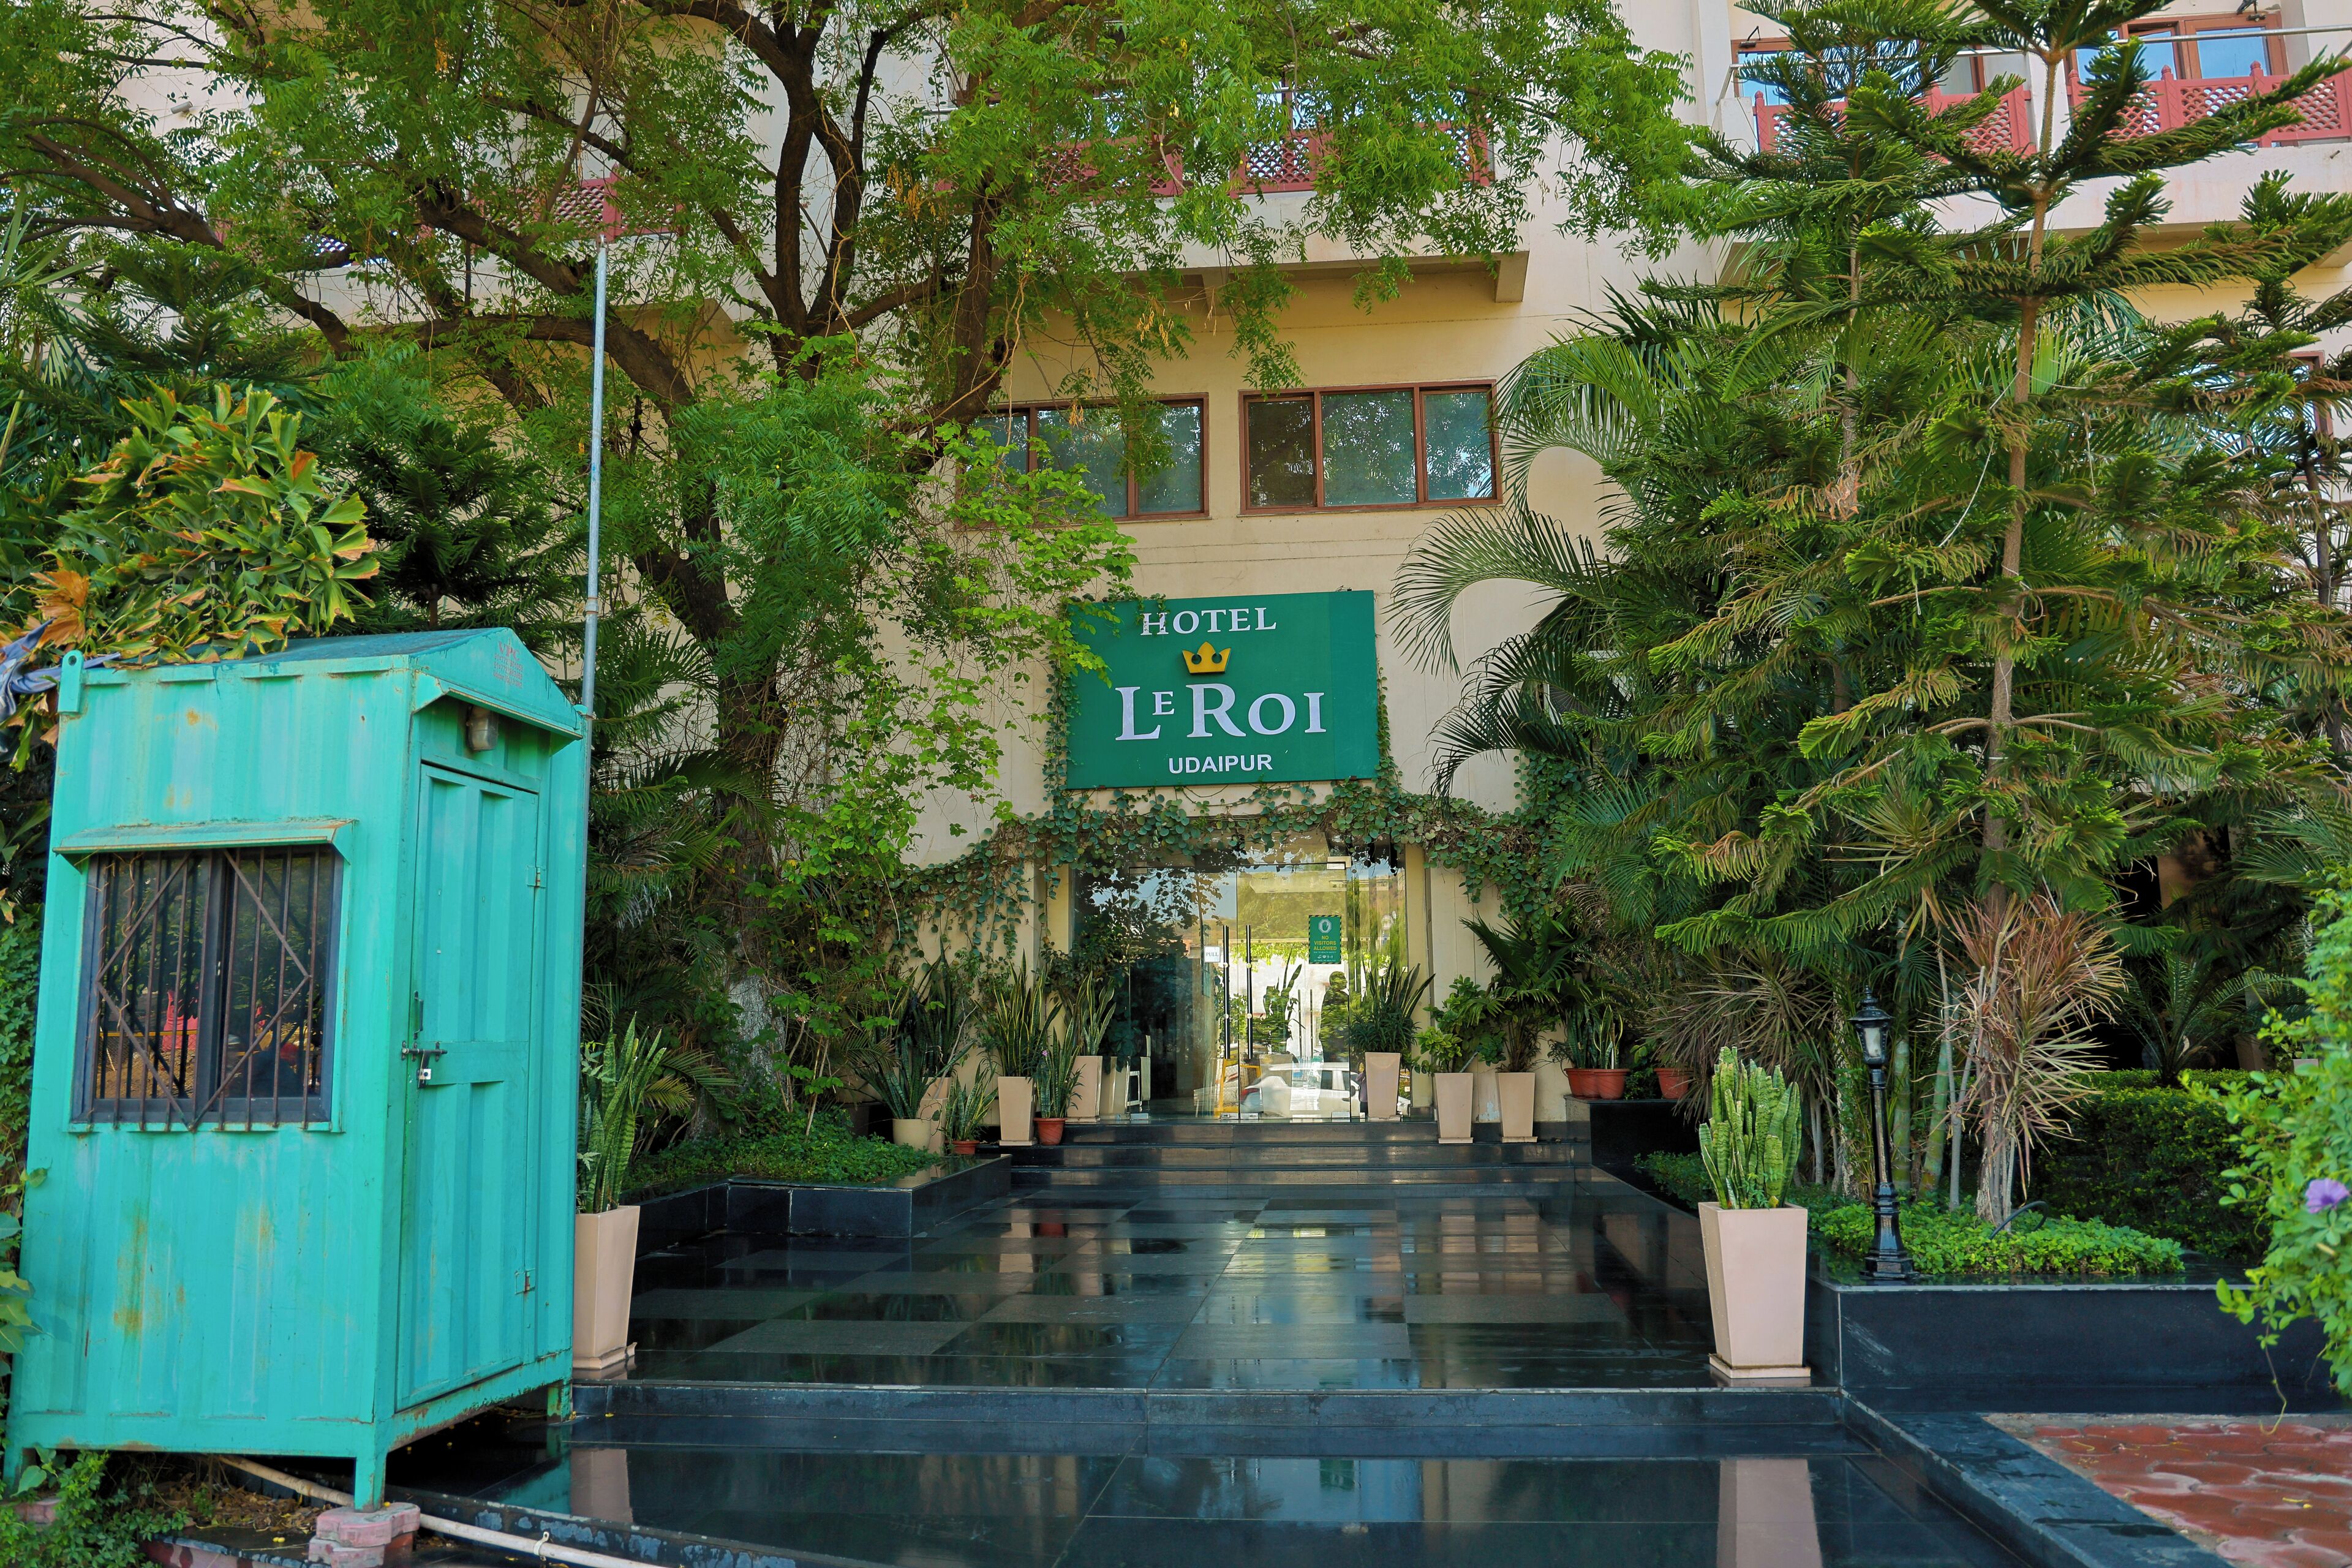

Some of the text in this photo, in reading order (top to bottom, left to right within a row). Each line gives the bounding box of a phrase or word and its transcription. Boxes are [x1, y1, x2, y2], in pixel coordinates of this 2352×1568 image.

[1140, 607, 1277, 636] HOTEL
[1115, 683, 1327, 741] LE ROI
[1168, 754, 1273, 774] UDAIPUR
